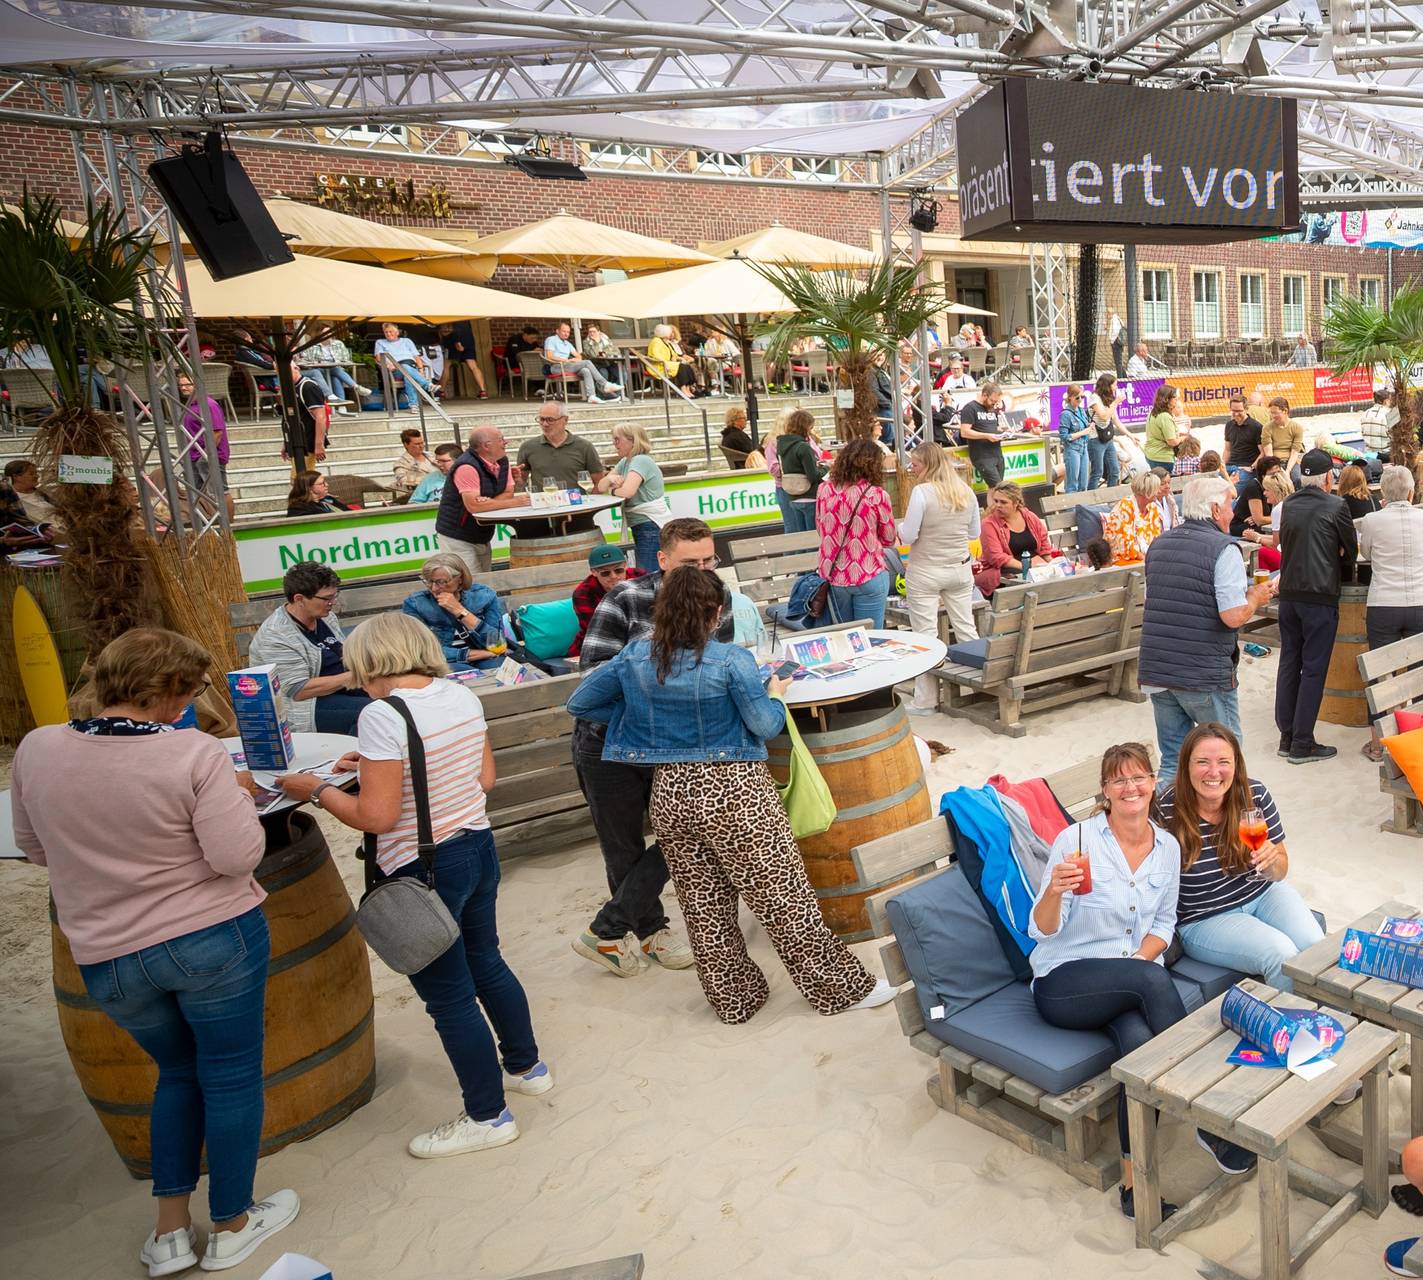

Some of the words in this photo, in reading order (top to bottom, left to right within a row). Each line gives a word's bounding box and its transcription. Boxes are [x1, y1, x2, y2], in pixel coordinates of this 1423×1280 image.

[959, 150, 1011, 222] präsent
[1031, 141, 1165, 207] iert
[1184, 384, 1245, 402] hölscher
[75, 466, 112, 475] moubis
[698, 489, 779, 515] Hoffma
